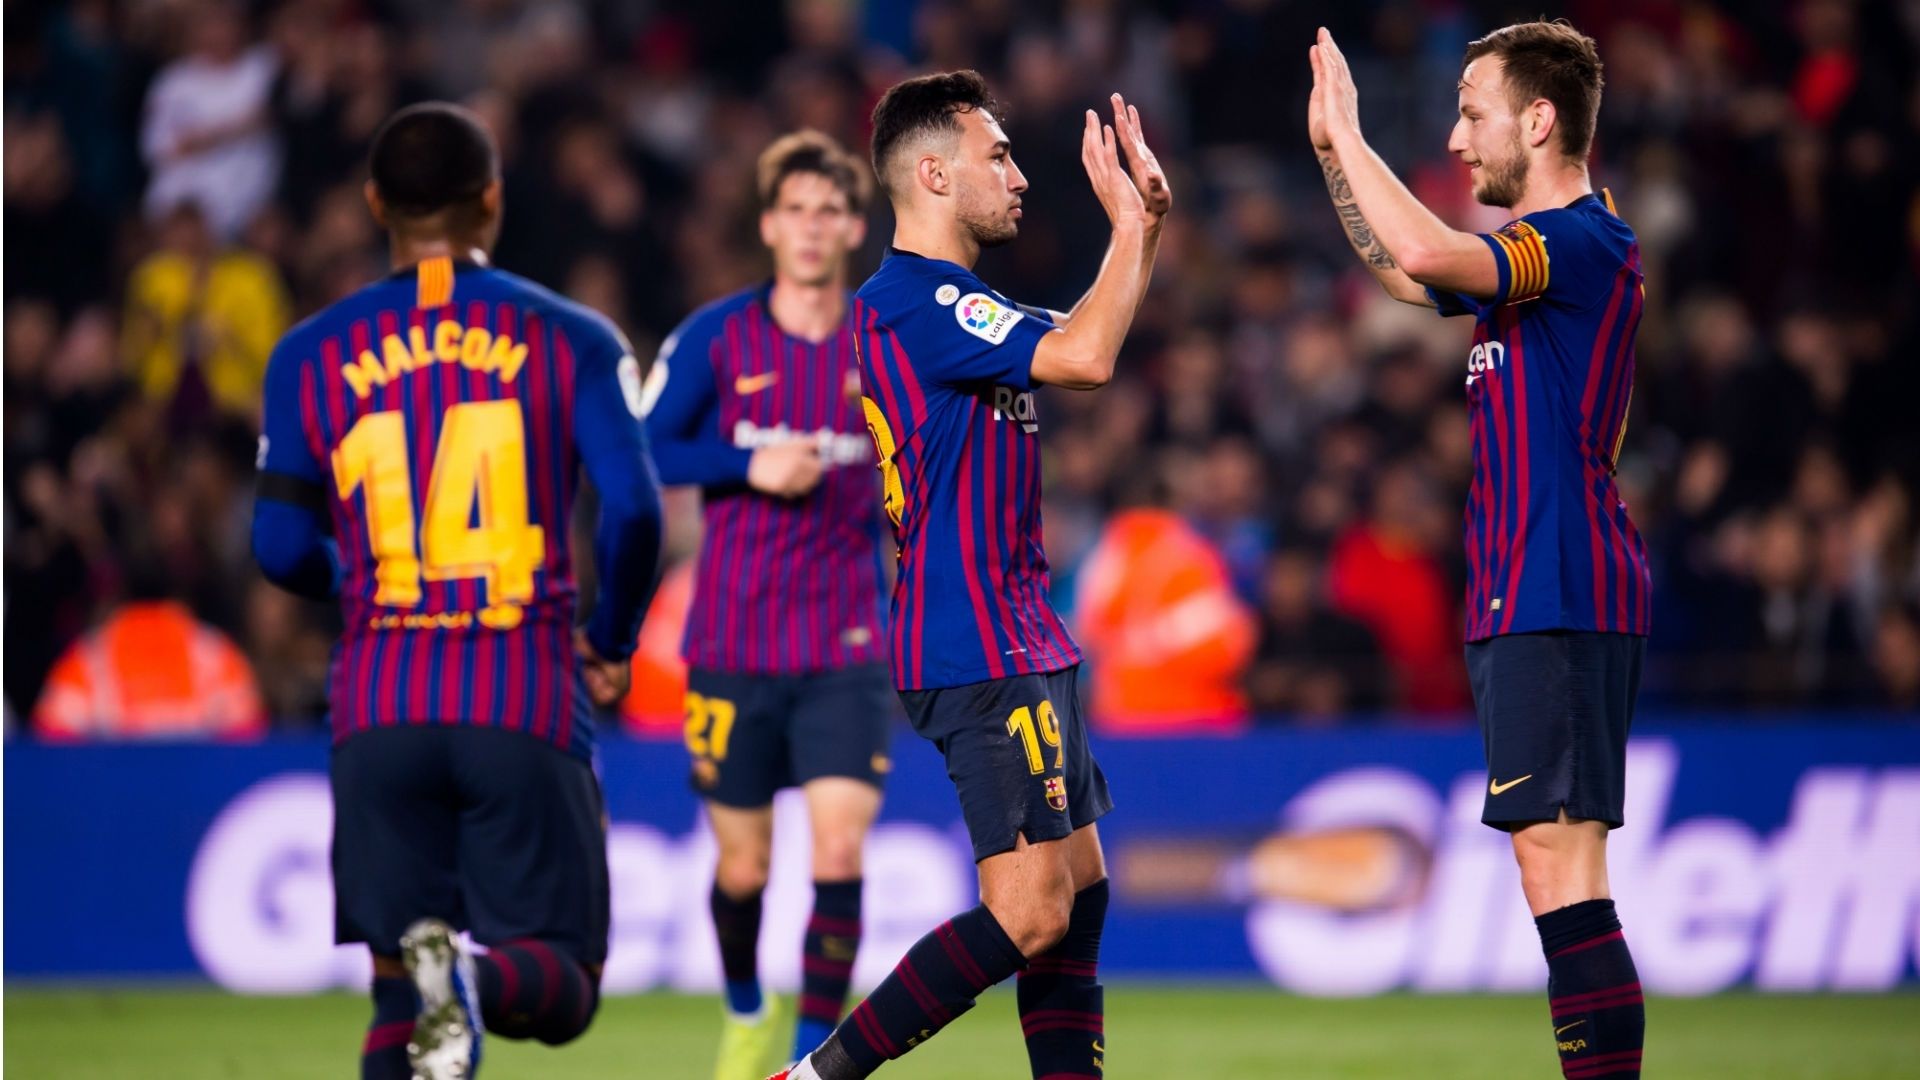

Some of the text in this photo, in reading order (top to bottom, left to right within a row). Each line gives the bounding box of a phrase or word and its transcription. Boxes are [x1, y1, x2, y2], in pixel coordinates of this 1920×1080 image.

[341, 319, 530, 399] MALCOM
[989, 311, 1015, 339] LaLiga
[331, 398, 545, 607] 14
[684, 691, 736, 760] 27
[1006, 700, 1064, 775] 19
